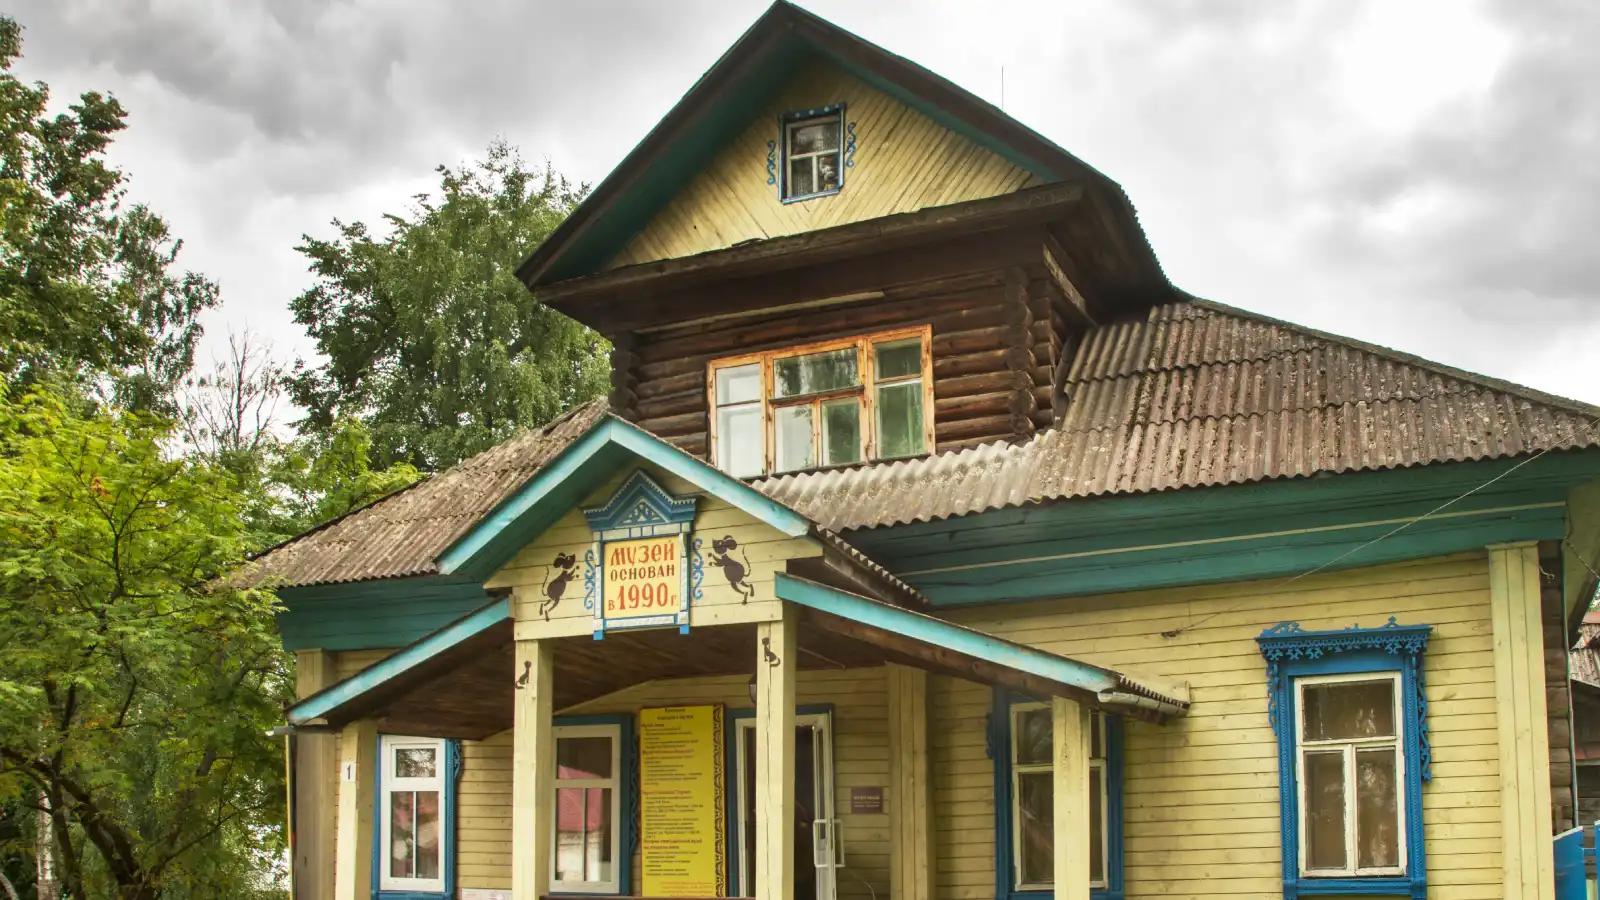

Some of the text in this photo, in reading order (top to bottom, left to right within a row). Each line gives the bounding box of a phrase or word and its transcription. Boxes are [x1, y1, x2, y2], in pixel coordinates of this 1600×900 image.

[610, 540, 674, 567] МУЗЕЙ
[610, 564, 675, 582] ОСНОВАН
[617, 582, 668, 610] 1990
[346, 764, 352, 780] 1
